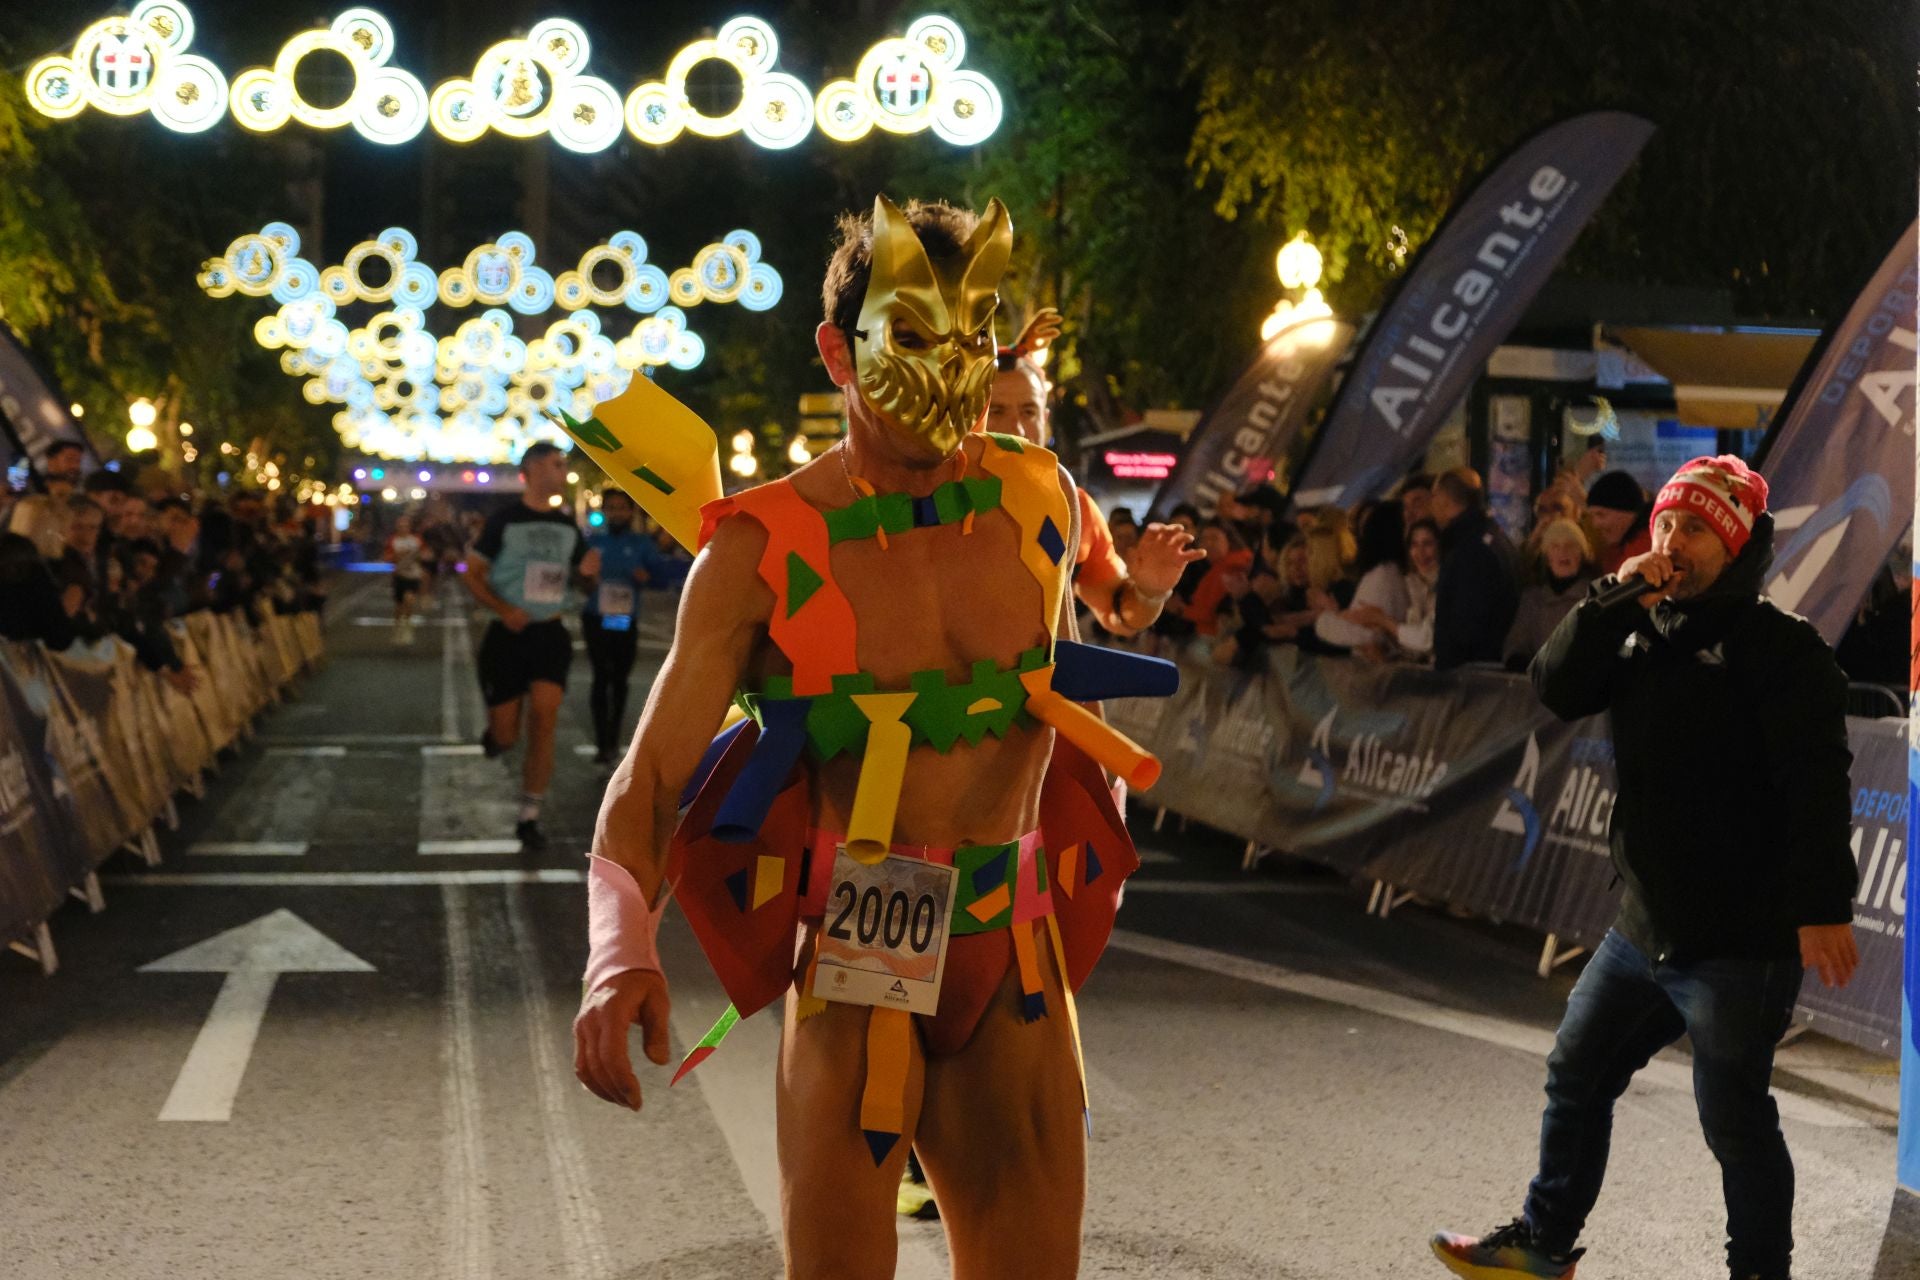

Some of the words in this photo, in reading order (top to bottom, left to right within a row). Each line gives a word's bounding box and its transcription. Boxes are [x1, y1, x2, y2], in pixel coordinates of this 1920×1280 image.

[1370, 164, 1567, 431] Alicante
[1656, 486, 1685, 505] OH
[1689, 490, 1739, 538] DEER!
[1344, 732, 1448, 798] Alicante
[827, 881, 935, 953] 2000
